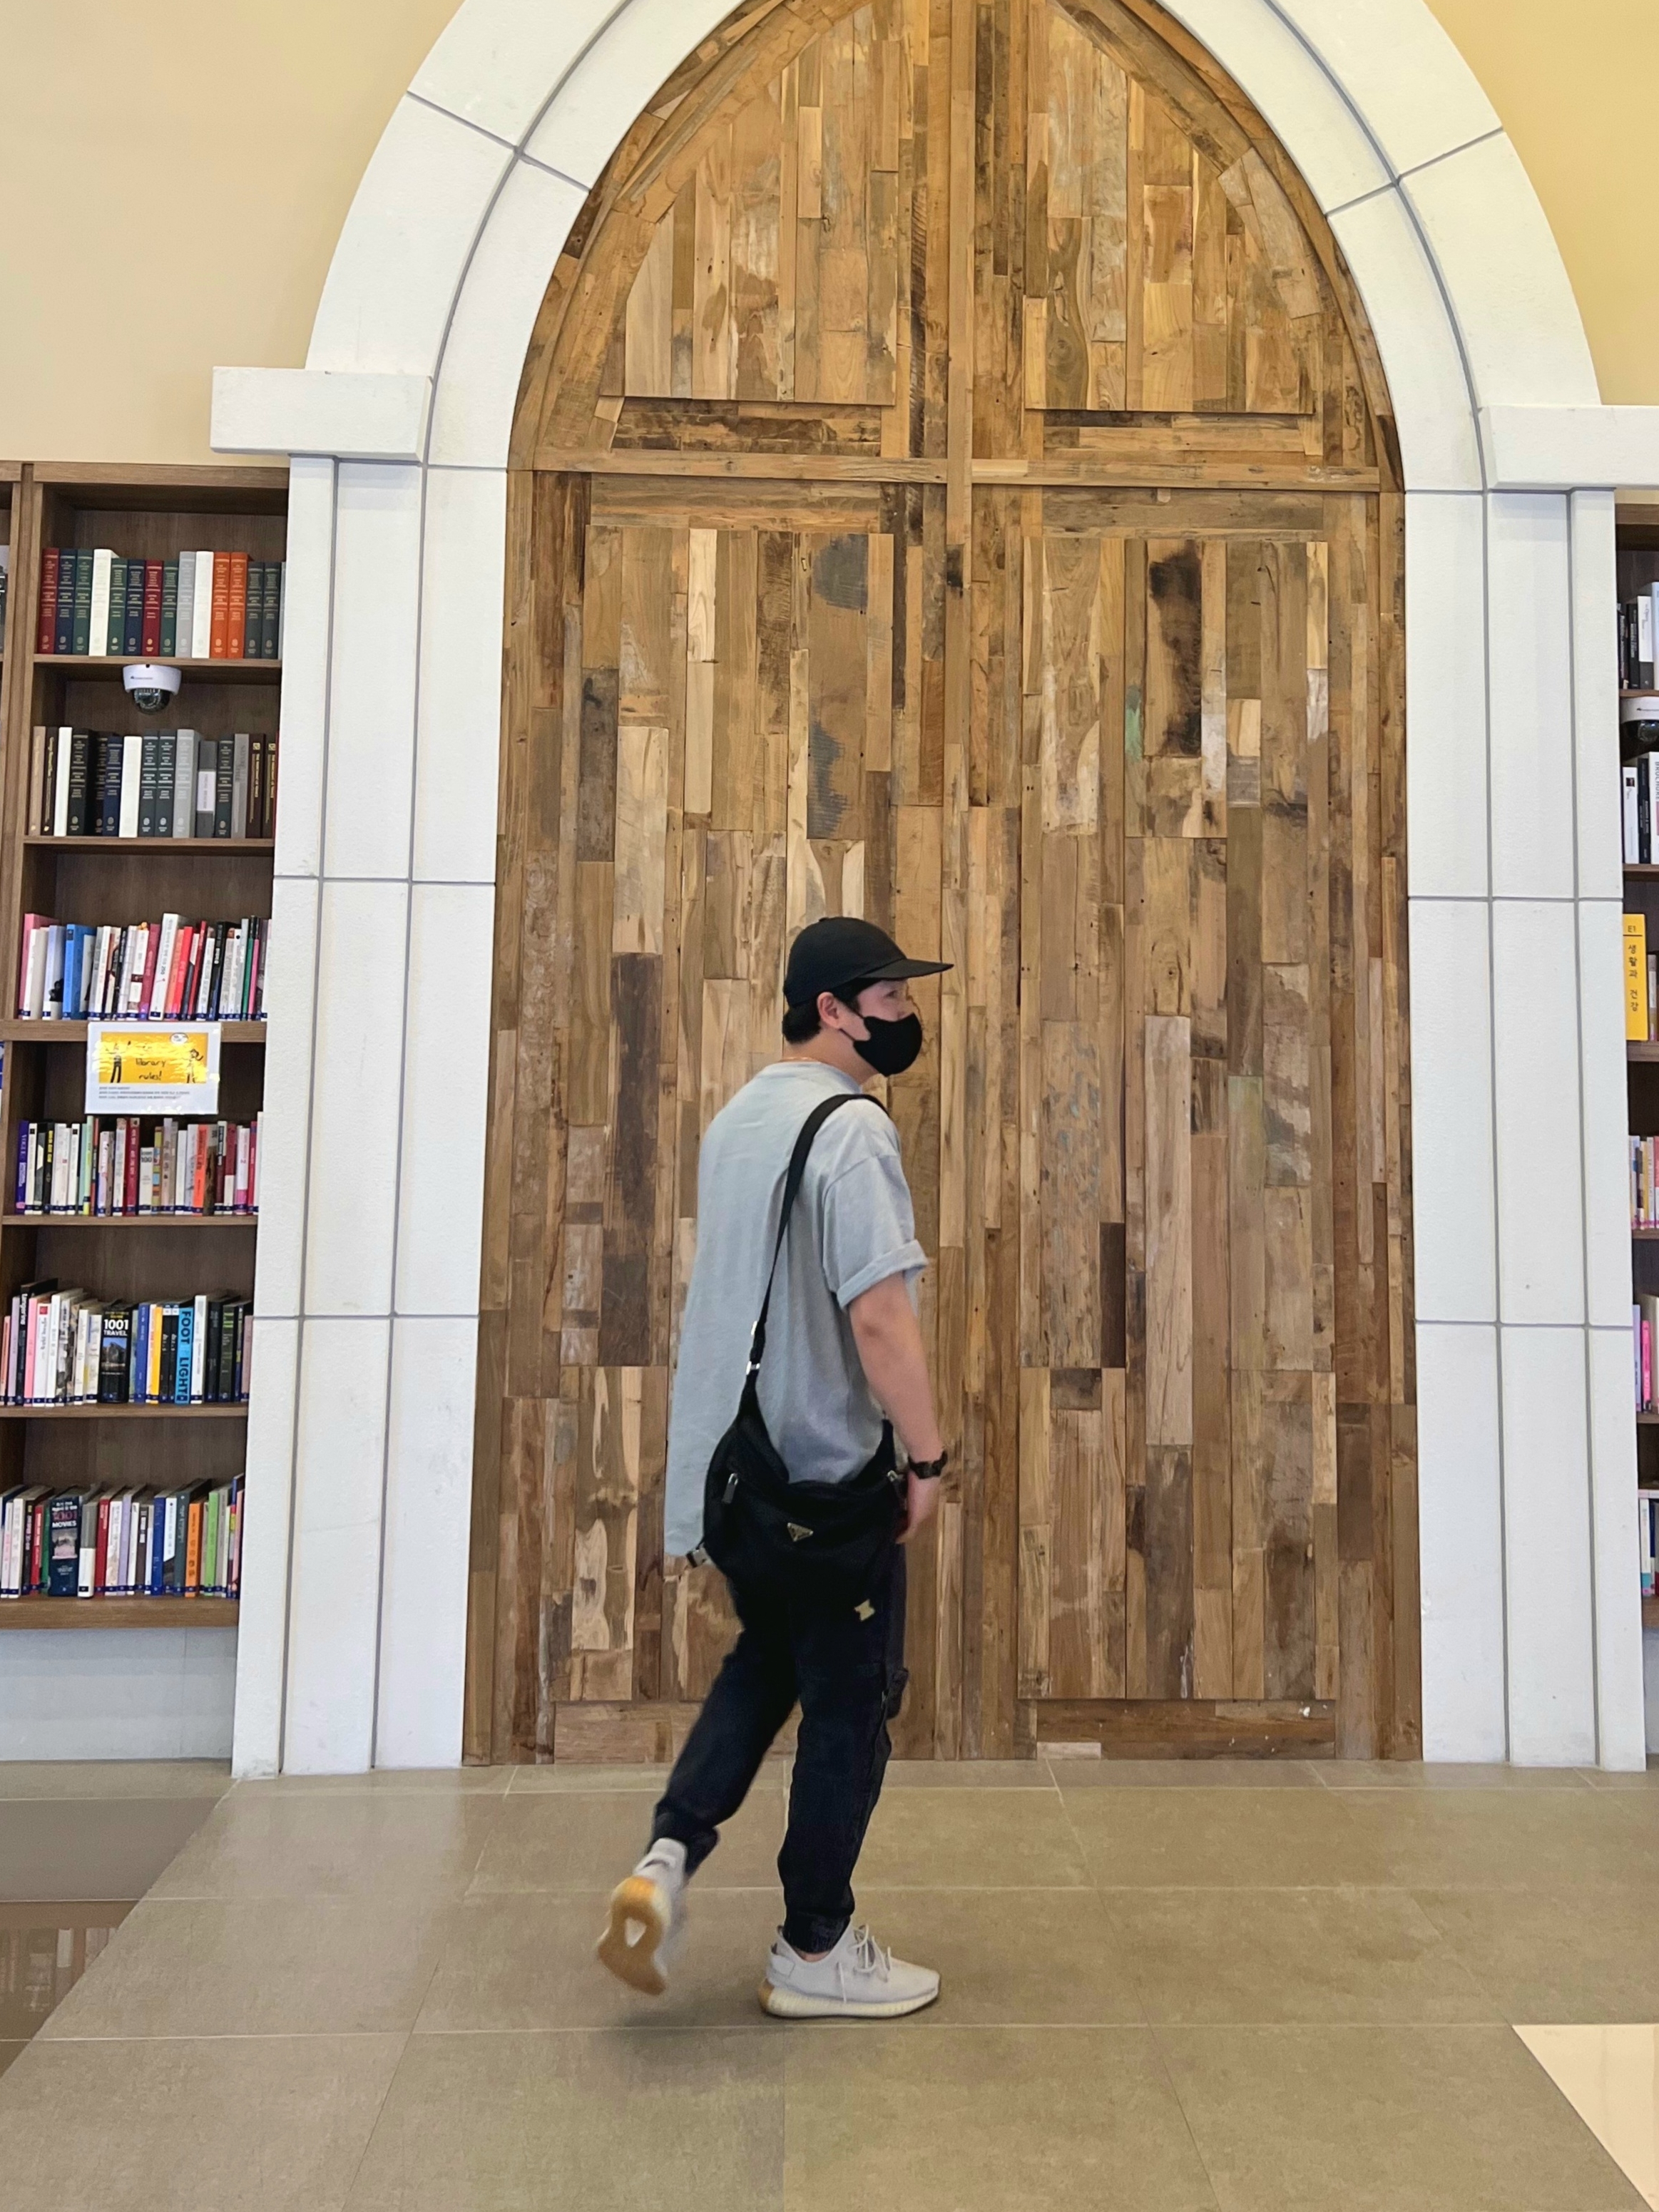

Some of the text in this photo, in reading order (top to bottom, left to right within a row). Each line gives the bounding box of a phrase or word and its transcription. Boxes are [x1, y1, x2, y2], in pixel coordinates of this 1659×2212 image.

[1628, 944, 1639, 1012] 생활과 건강
[136, 1058, 166, 1067] library
[138, 1070, 162, 1081] rules!
[104, 1319, 129, 1330] 1001
[181, 1311, 191, 1344] FOOT
